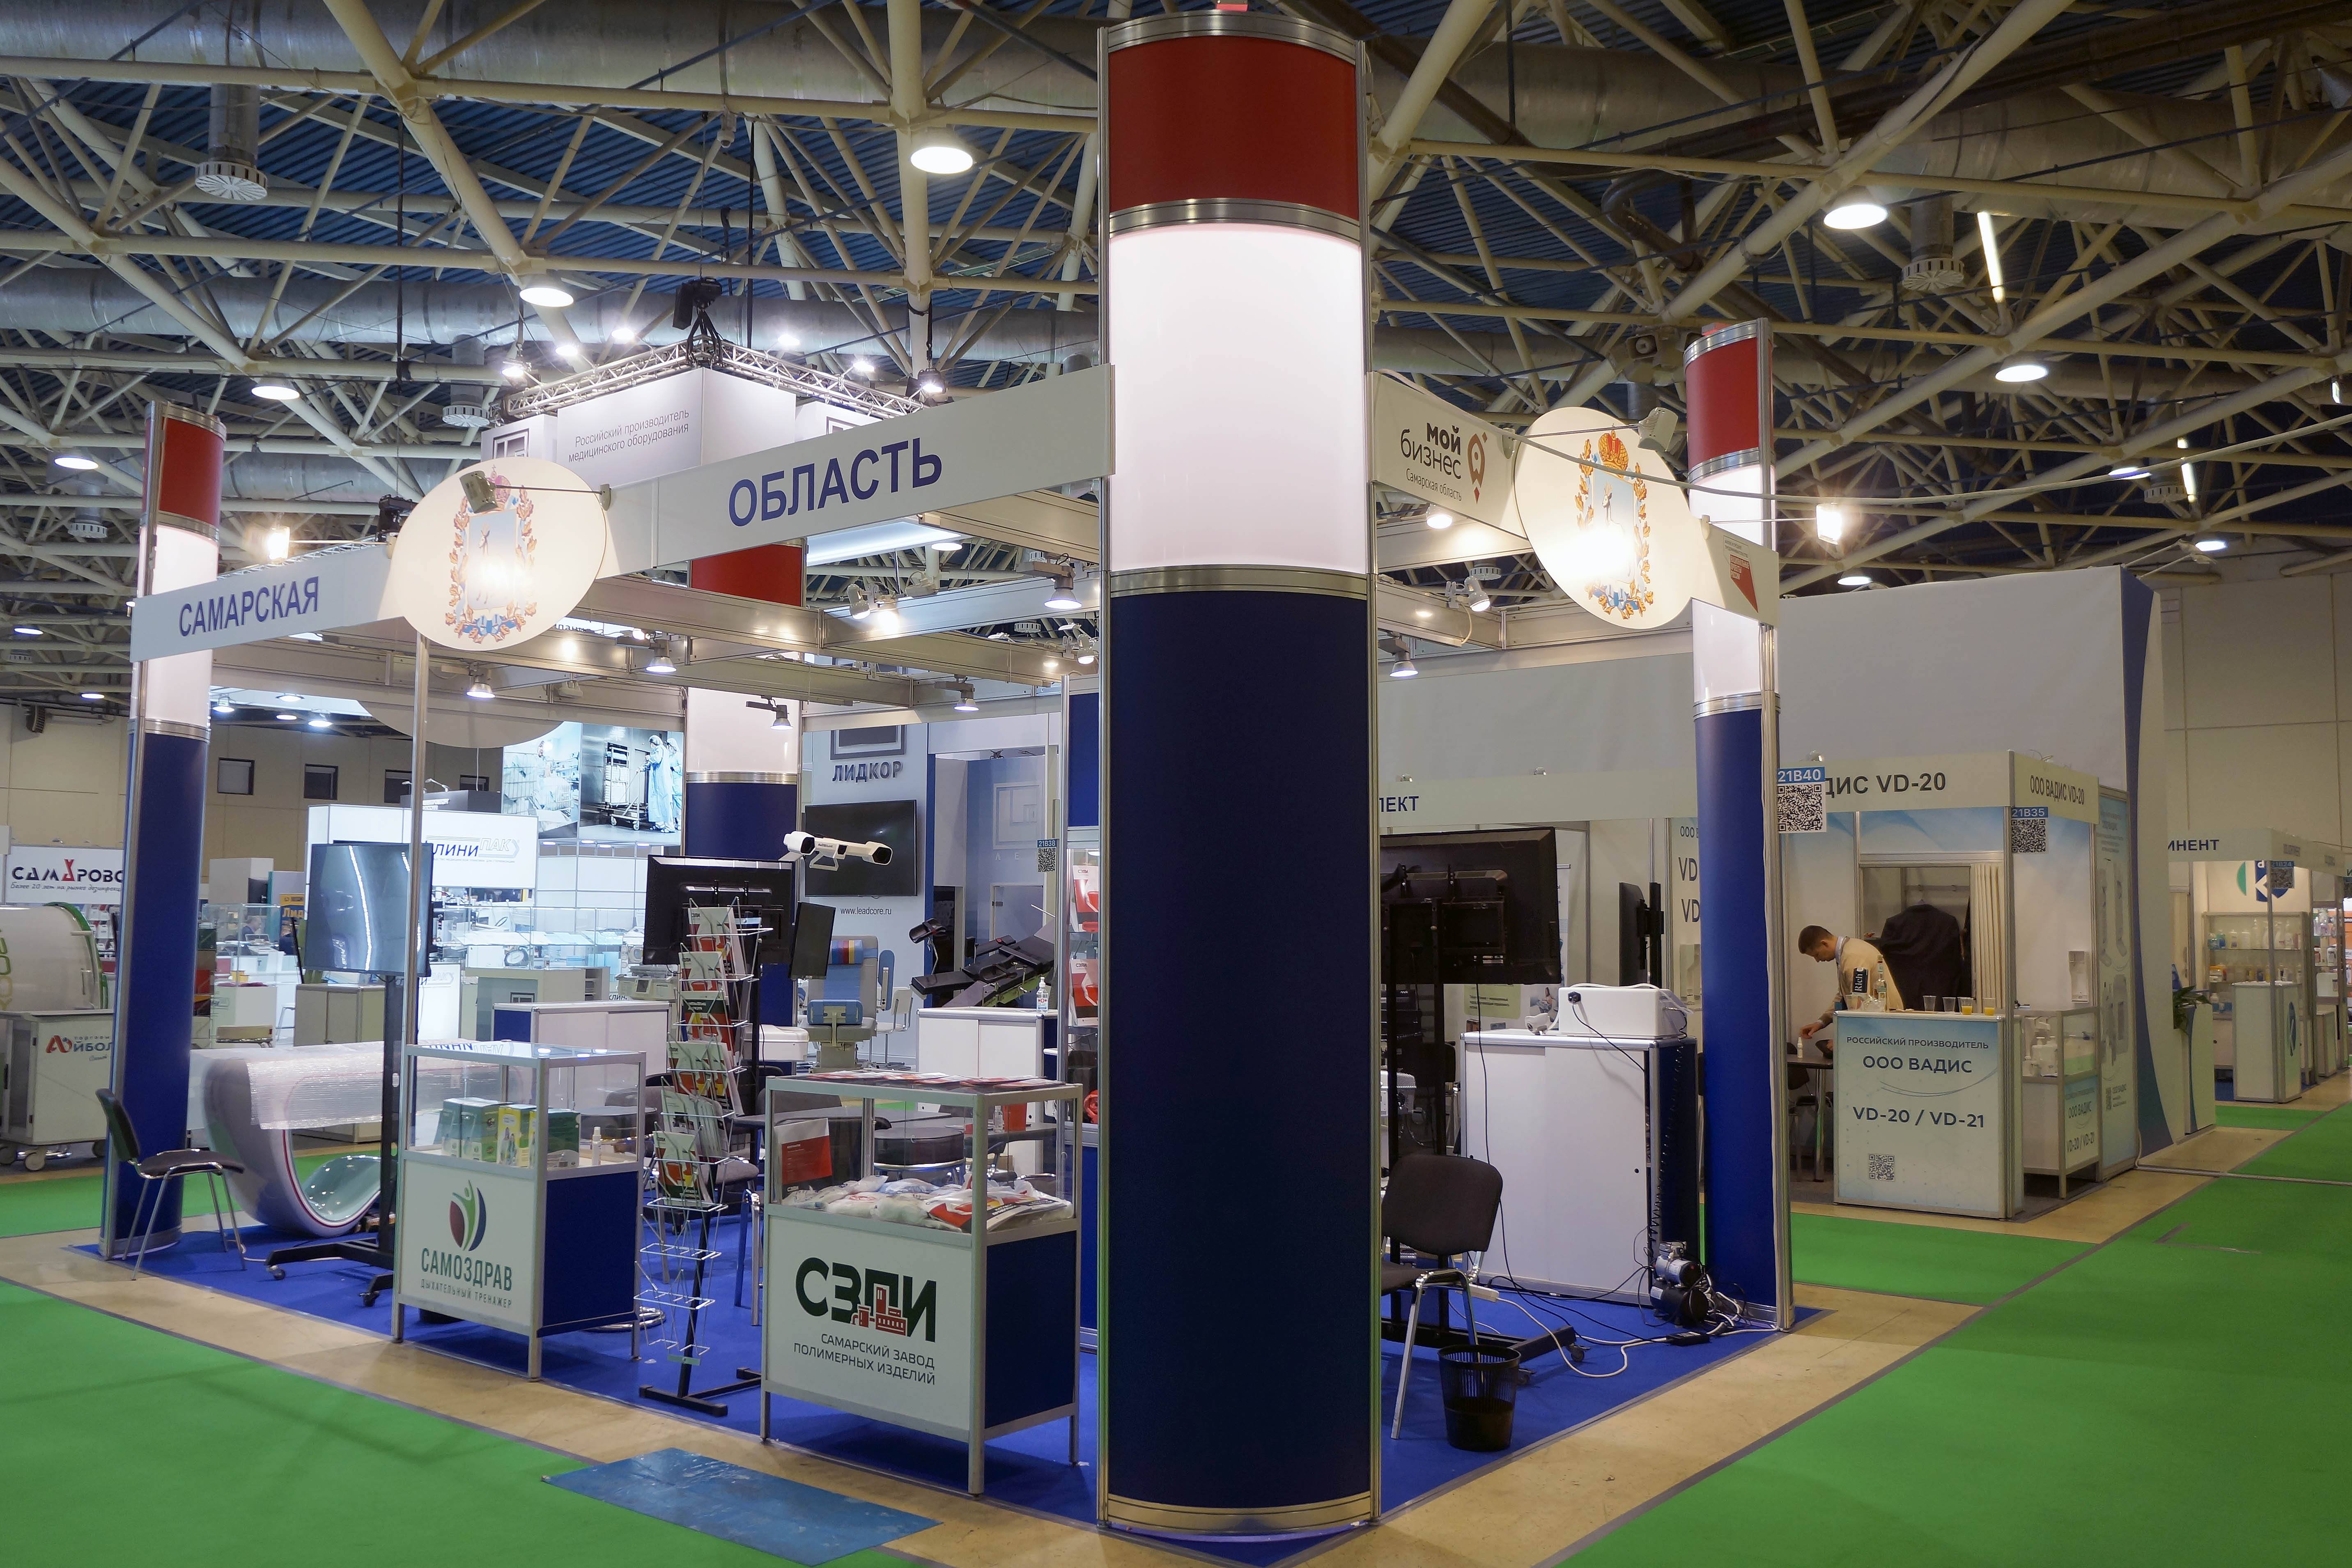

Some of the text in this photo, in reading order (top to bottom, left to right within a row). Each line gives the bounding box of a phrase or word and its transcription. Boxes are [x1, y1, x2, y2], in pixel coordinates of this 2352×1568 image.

[575, 409, 689, 447] Российский производитель
[569, 424, 689, 462] медицинского оборудования
[1400, 429, 1461, 479] бизнес
[729, 437, 942, 527] ОБЛАСТЬ
[1406, 468, 1462, 501] Самарская область
[179, 576, 319, 637] САМАРСКАЯ
[832, 761, 902, 783] ЛИДКОР
[1778, 769, 1821, 782] 21B40
[1876, 772, 1946, 792] VD-20
[2030, 775, 2085, 805] ООО ВАДИС VD-20
[2012, 808, 2045, 817] 21B35
[1678, 857, 1697, 881] VD
[841, 907, 891, 915] www.leadcore.ru
[1854, 974, 1863, 991] Rich
[1847, 1037, 1989, 1049] РОССИЙСКИЙ ПРОИЗВОДИТЕЛЬ
[1863, 1056, 1972, 1074] ООО ВАДИС
[1852, 1107, 1984, 1128] VD-20 / VD-21
[421, 1247, 512, 1291] САМОЗДРАВ
[420, 1279, 512, 1308] ДЫХАТЕЛЬНЫЙ ТРЕНАЖЕР
[795, 1257, 937, 1343] СЗПИ
[794, 1342, 935, 1385] ПОЛИМЕРНЫХ ИЗДЕЛИЙ
[821, 1333, 935, 1371] САМАРСКИЙ ЗАВОД
